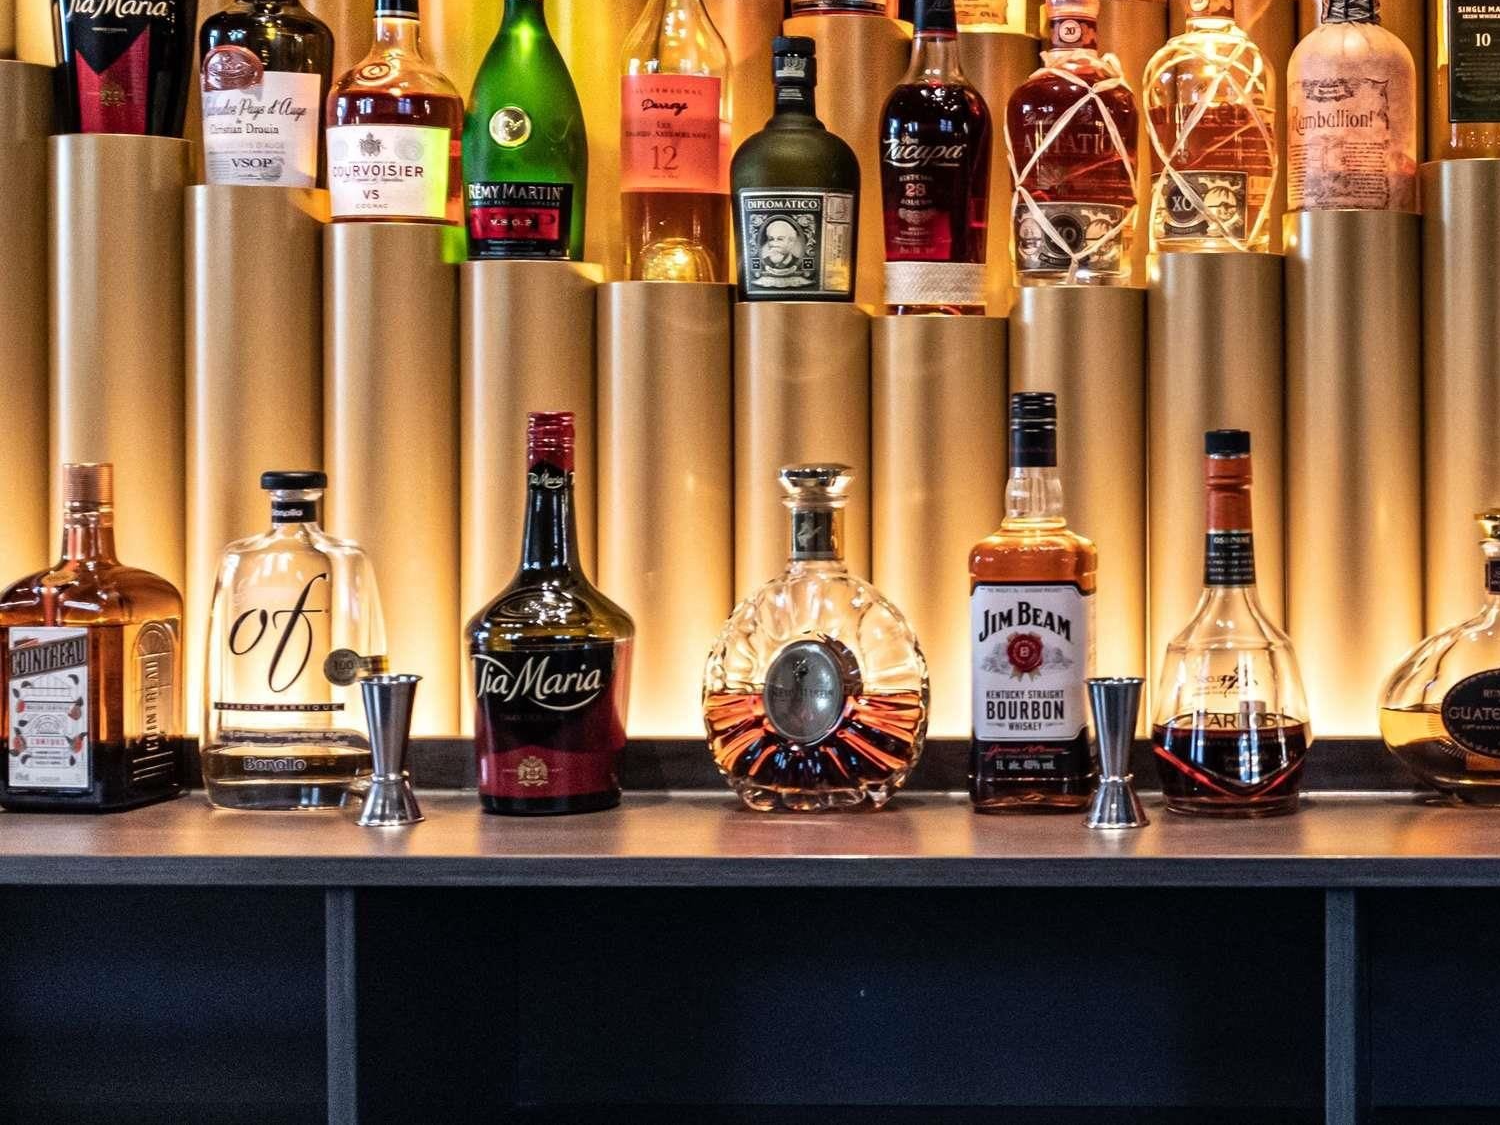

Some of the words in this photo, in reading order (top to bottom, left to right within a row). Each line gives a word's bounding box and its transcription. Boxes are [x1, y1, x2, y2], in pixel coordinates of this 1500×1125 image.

[1063, 26, 1077, 37] 20
[1475, 33, 1491, 47] 10
[231, 158, 272, 168] VSOP
[650, 145, 680, 171] 12
[333, 165, 424, 178] COURVOISIER
[362, 190, 380, 200] VS
[503, 183, 561, 201] MARTIN
[979, 608, 1014, 643] JIM
[1017, 601, 1072, 642] BEAM
[12, 639, 86, 676] COINTREAU
[473, 654, 514, 700] Tia
[505, 655, 604, 707] Maria
[986, 690, 1025, 699] KENTUCKY
[1028, 690, 1064, 699] STRAIGHT
[986, 701, 1065, 720] BOURBON
[1008, 722, 1043, 731] WHISKEY
[244, 756, 307, 772] Bonollo
